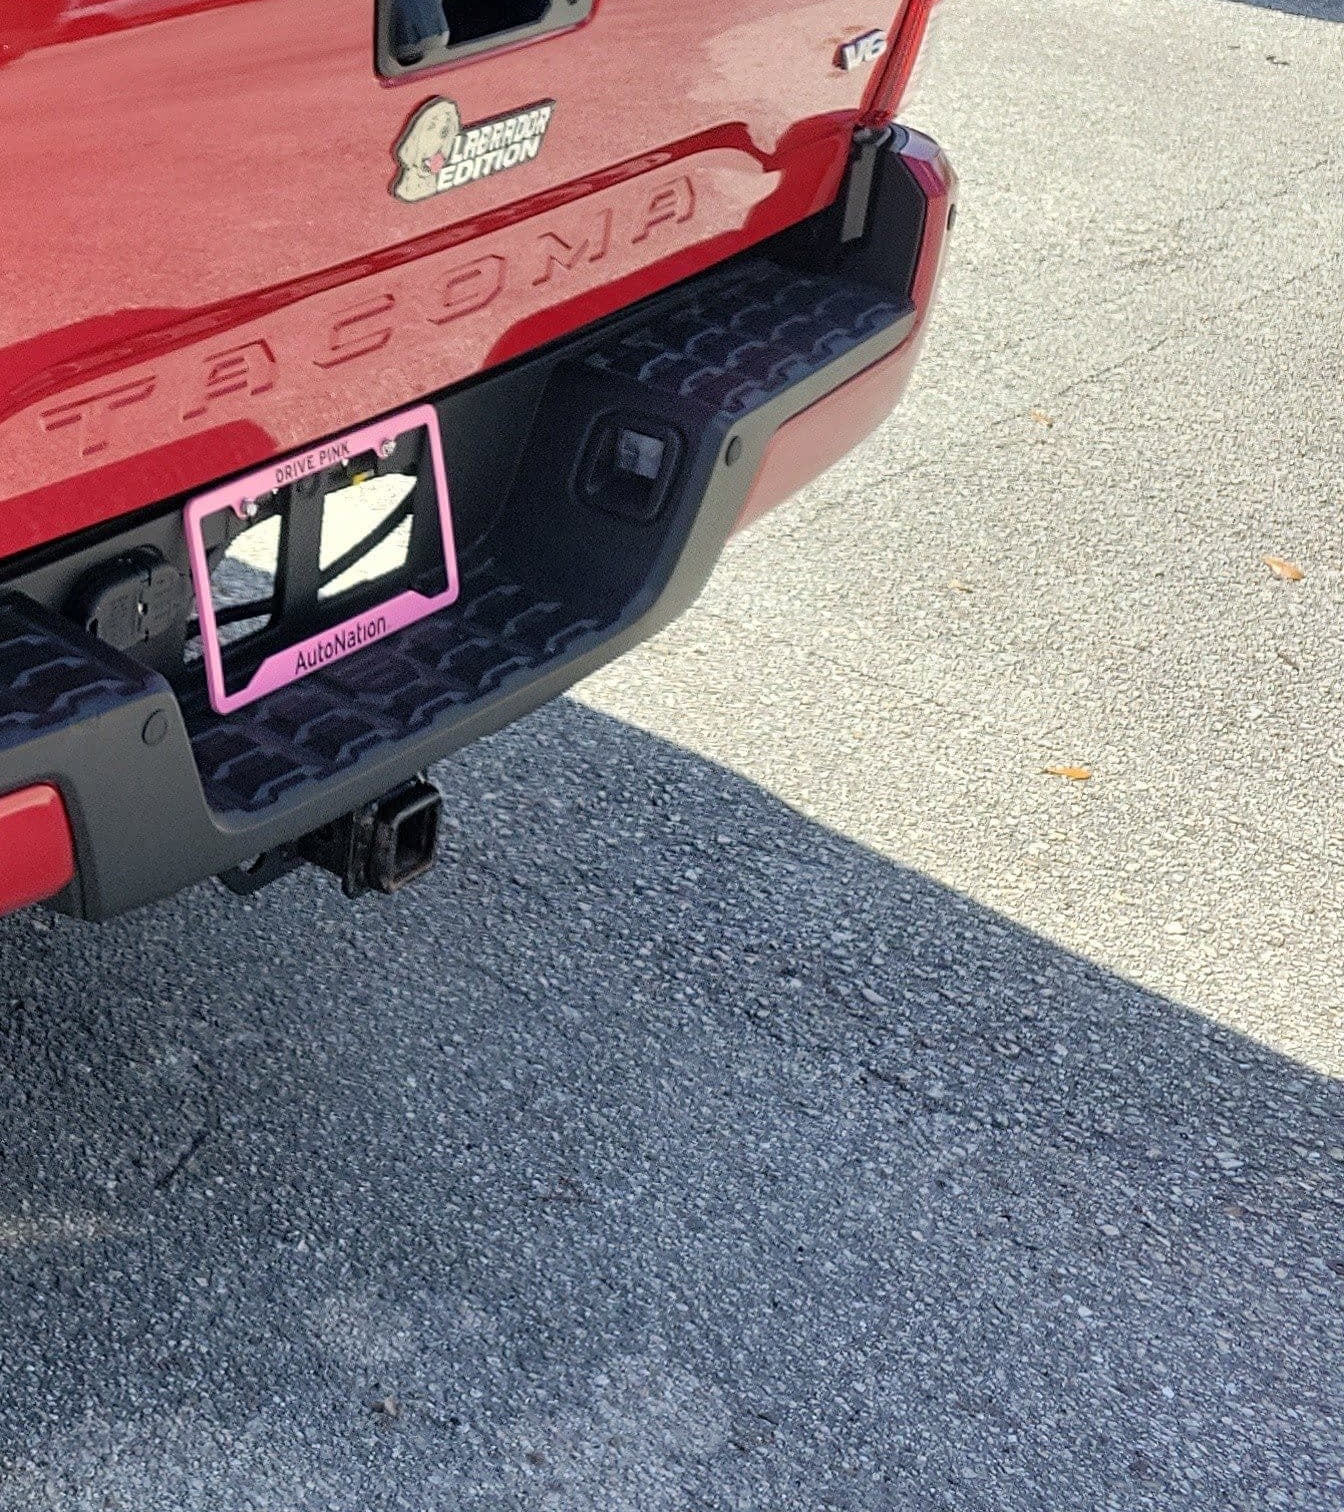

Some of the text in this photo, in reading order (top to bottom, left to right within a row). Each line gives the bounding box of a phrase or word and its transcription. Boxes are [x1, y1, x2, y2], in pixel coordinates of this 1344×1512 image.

[842, 29, 888, 72] V6
[437, 134, 541, 191] EDITION
[449, 106, 552, 165] LABRADOR
[40, 174, 697, 457] TACOMA
[275, 440, 351, 484] DRIVE PINK
[295, 615, 387, 675] AutoNation
